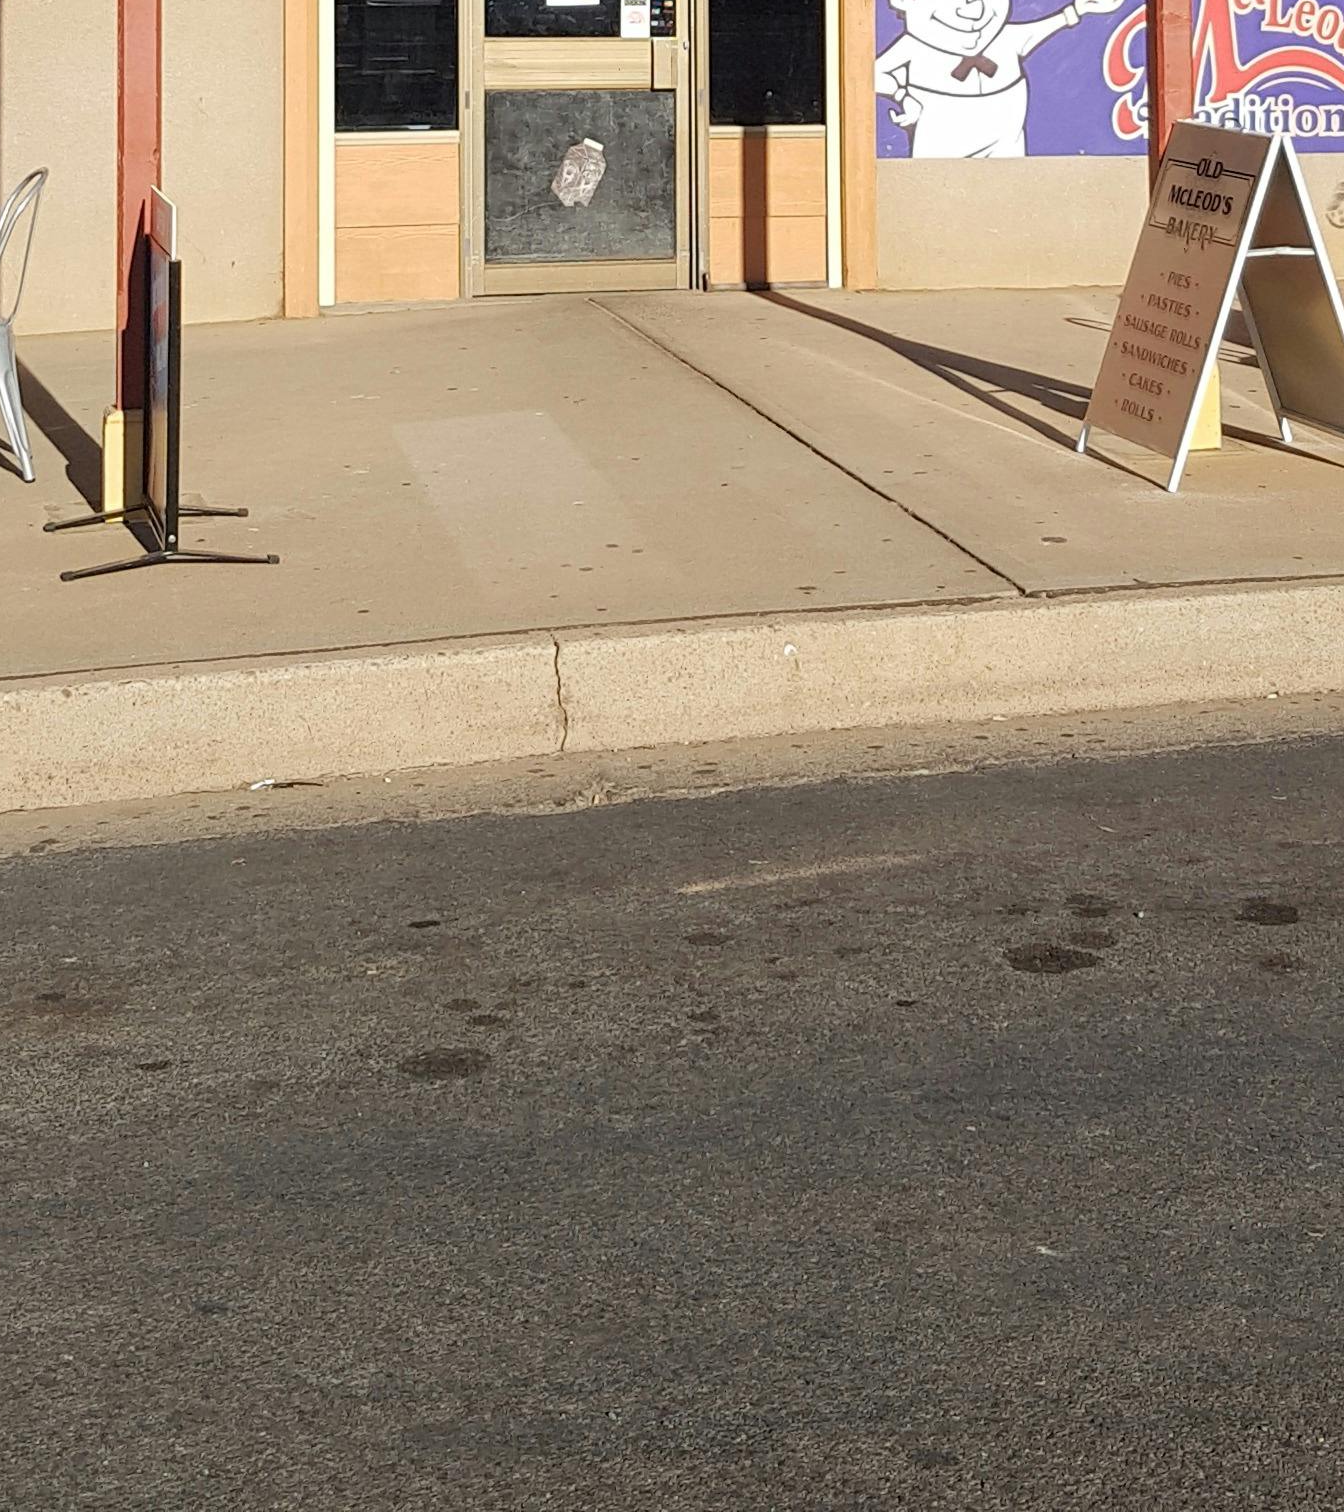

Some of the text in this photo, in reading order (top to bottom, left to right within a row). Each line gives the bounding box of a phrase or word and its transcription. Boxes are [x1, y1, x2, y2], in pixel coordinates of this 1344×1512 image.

[1197, 158, 1223, 178] OLD
[1166, 217, 1217, 251] BAKERY
[1167, 271, 1191, 289] PIES
[1147, 294, 1191, 318] PASTIES
[1124, 314, 1201, 350] SAUSAGE ROLLS
[1121, 341, 1188, 375] SANDWICHES
[1129, 373, 1164, 396] CAKES
[1121, 399, 1154, 422] ROLLS
